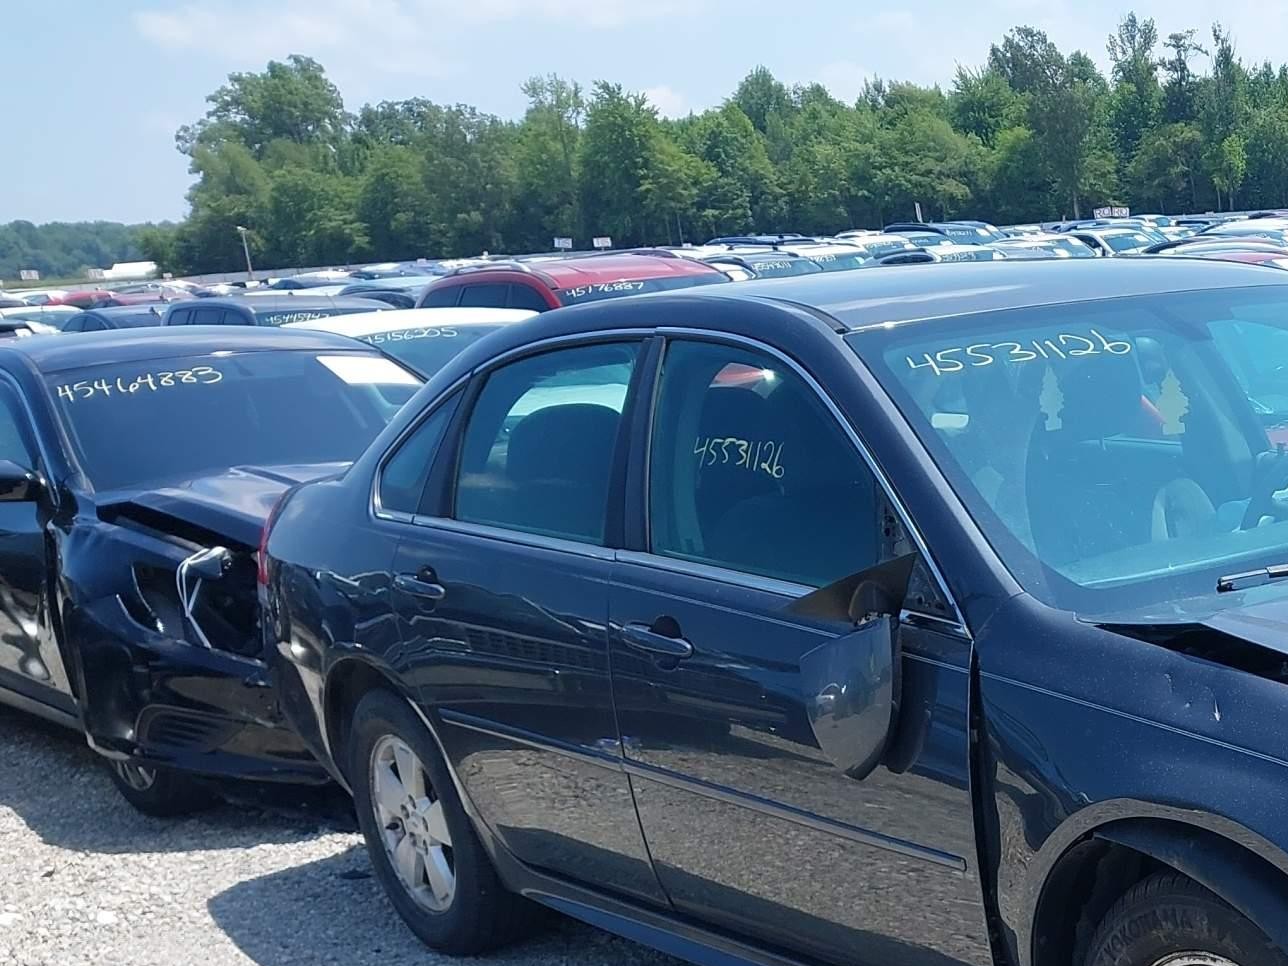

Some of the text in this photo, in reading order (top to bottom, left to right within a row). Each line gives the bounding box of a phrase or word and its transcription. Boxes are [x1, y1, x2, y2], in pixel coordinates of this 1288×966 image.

[566, 281, 644, 297] 45176887
[905, 329, 1131, 375] 45531126
[57, 366, 223, 402] 45464883
[693, 436, 785, 478] 45531126
